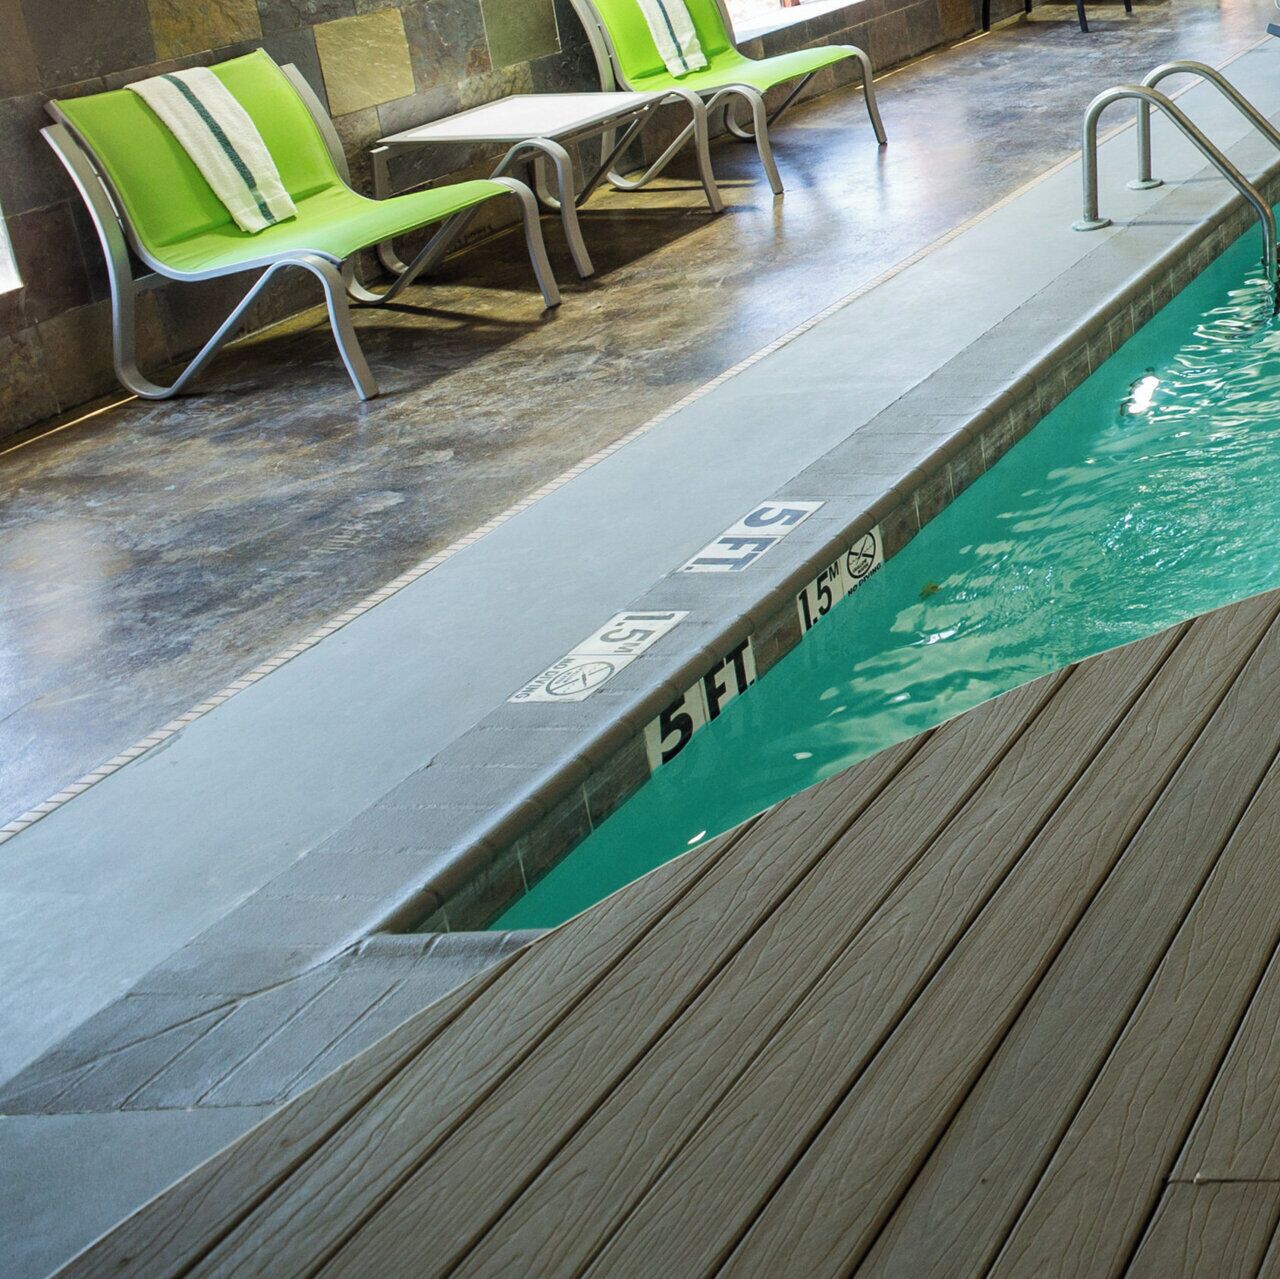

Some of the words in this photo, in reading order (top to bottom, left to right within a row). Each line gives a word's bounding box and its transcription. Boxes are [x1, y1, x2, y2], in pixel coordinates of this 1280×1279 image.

[743, 505, 802, 528] 5
[848, 584, 858, 596] NO
[858, 562, 882, 586] DIVING
[552, 658, 576, 670] NO
[515, 670, 554, 700] DIVING
[660, 694, 694, 766] 5
